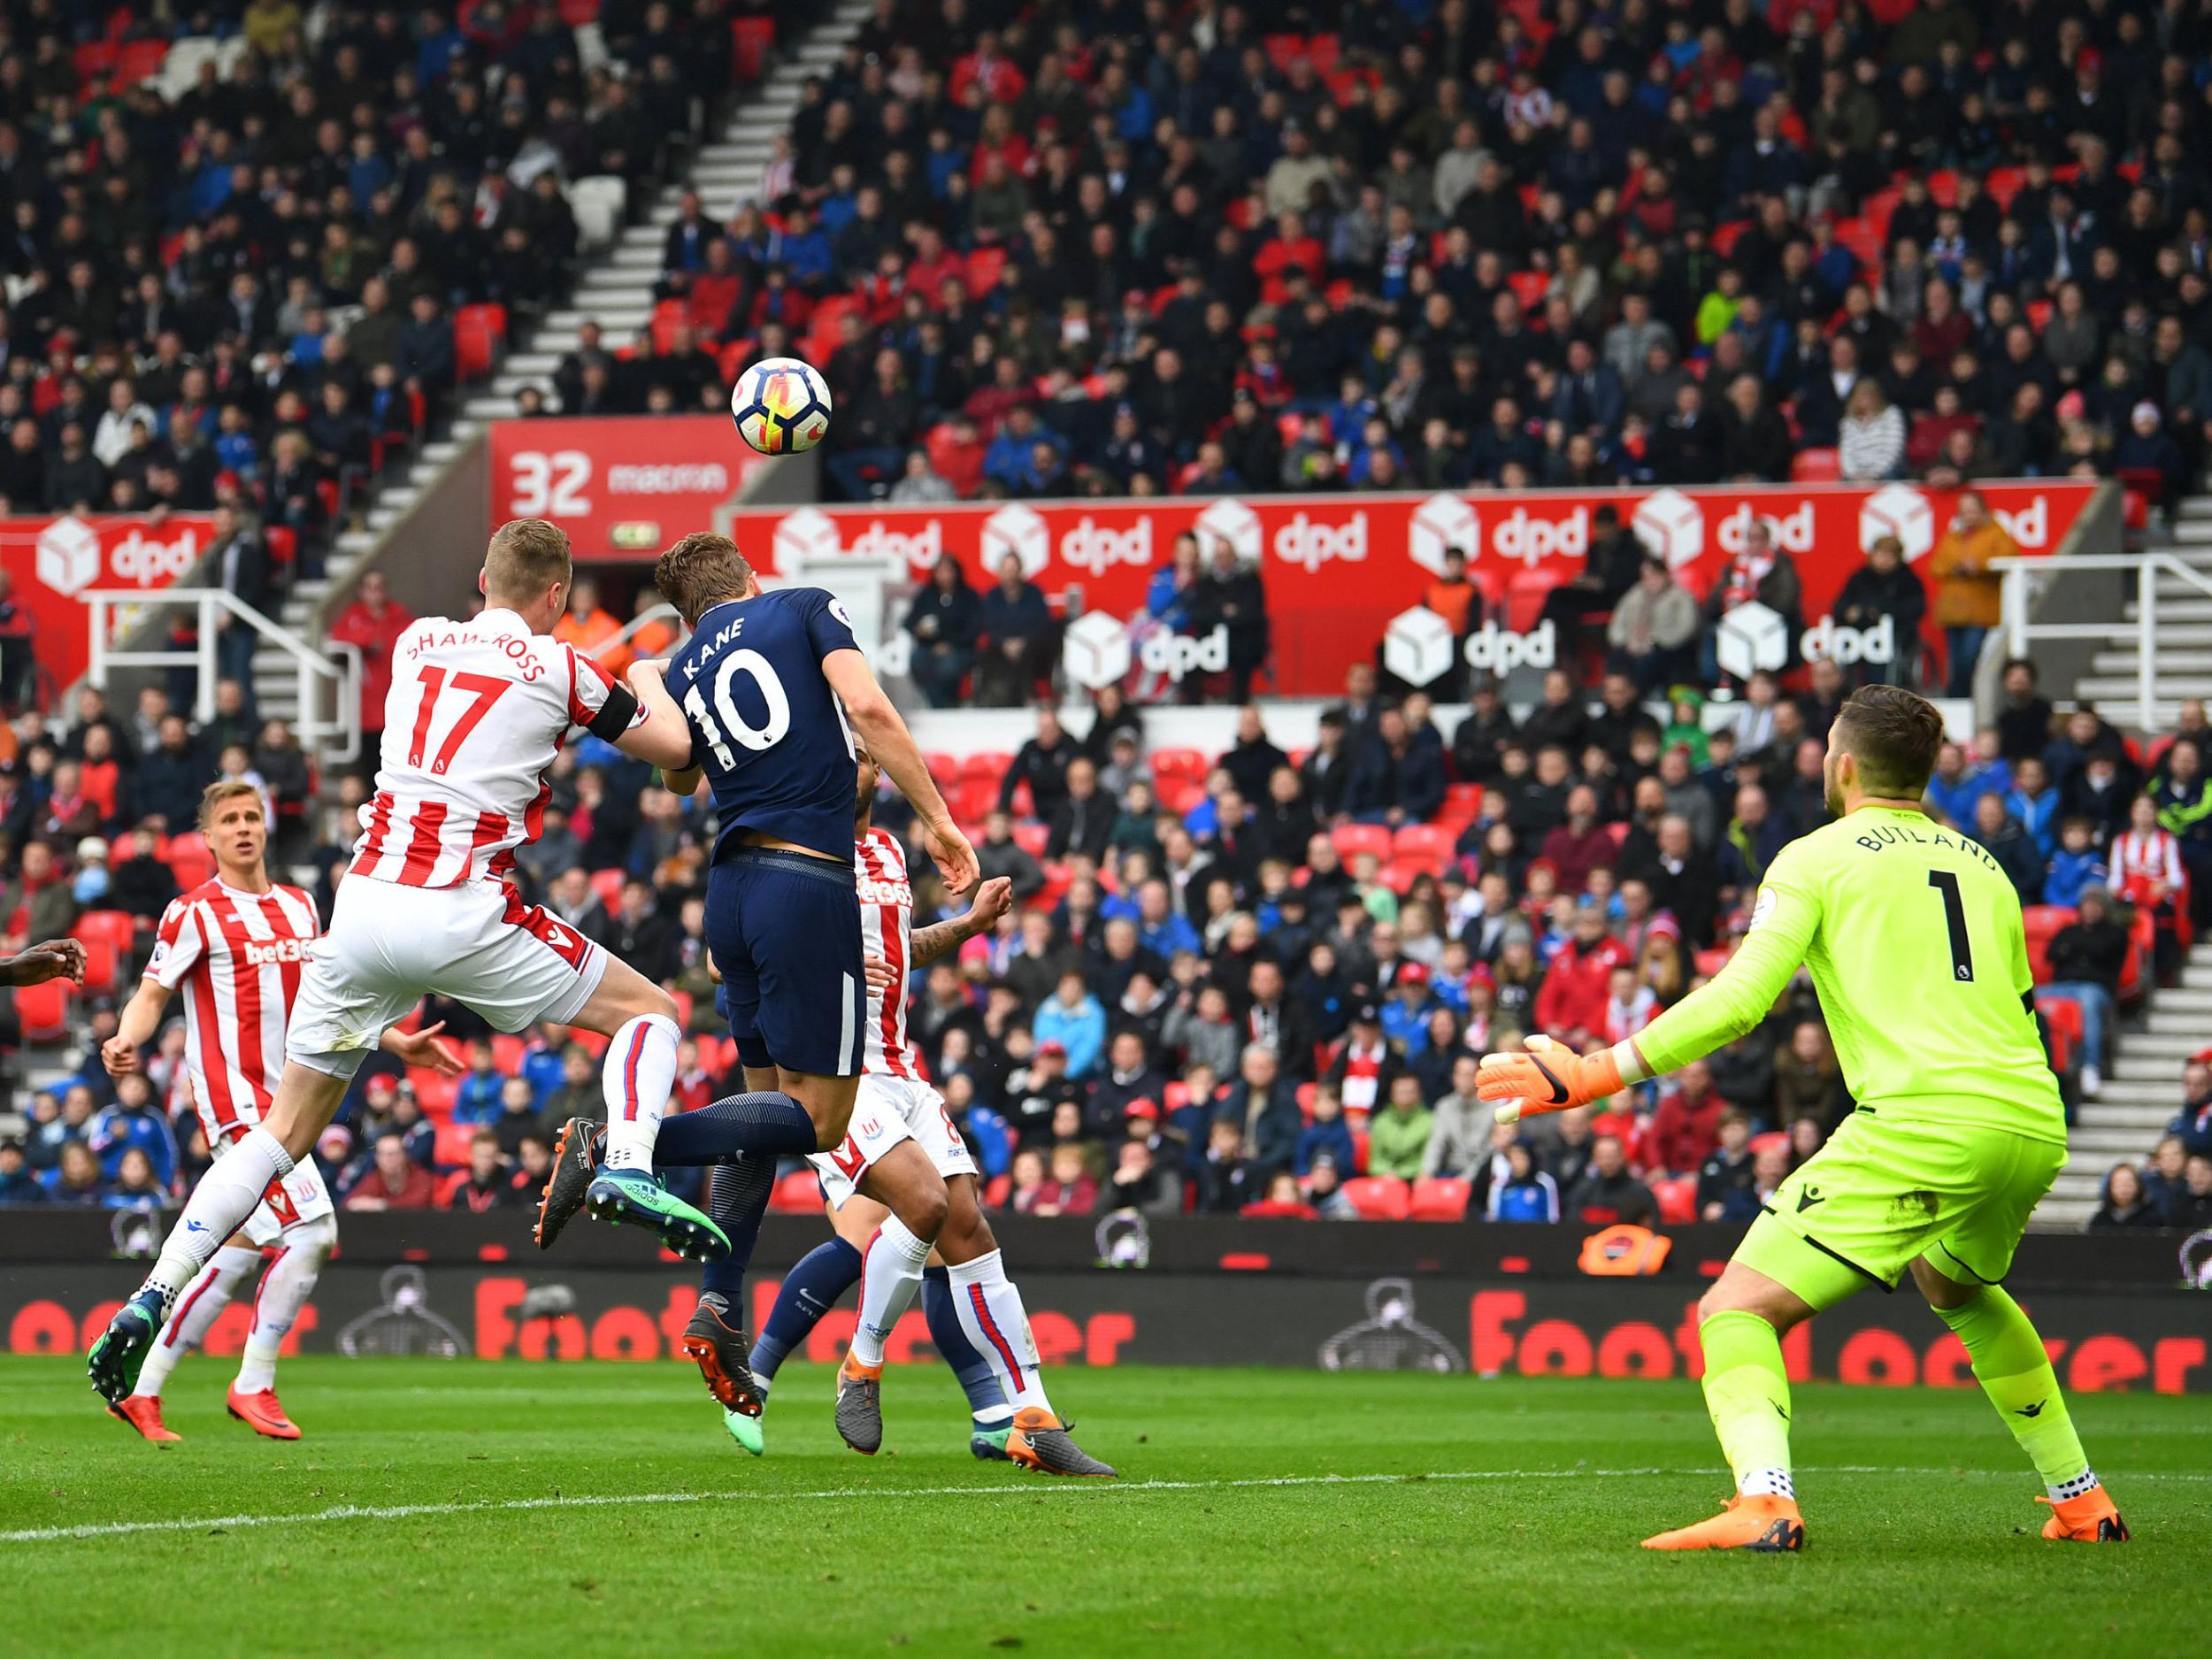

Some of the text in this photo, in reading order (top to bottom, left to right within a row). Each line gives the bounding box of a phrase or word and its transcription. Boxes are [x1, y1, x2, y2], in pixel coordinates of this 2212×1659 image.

[510, 449, 594, 517] 32
[111, 528, 196, 590] dpd
[1062, 515, 1154, 578] dpd
[1273, 511, 1369, 573] dpd
[1494, 504, 1589, 568] dpd
[407, 632, 545, 682] SHAWROSS
[682, 618, 745, 681] KANE
[1140, 622, 1229, 684] dpd
[1464, 618, 1556, 679] dpd
[408, 665, 513, 776] 17
[683, 649, 791, 772] 10
[1856, 826, 1996, 872] BUTLAND
[856, 876, 913, 907] et365
[244, 939, 312, 965] bet36
[1929, 869, 1974, 982] 1
[625, 1183, 660, 1206] adidas
